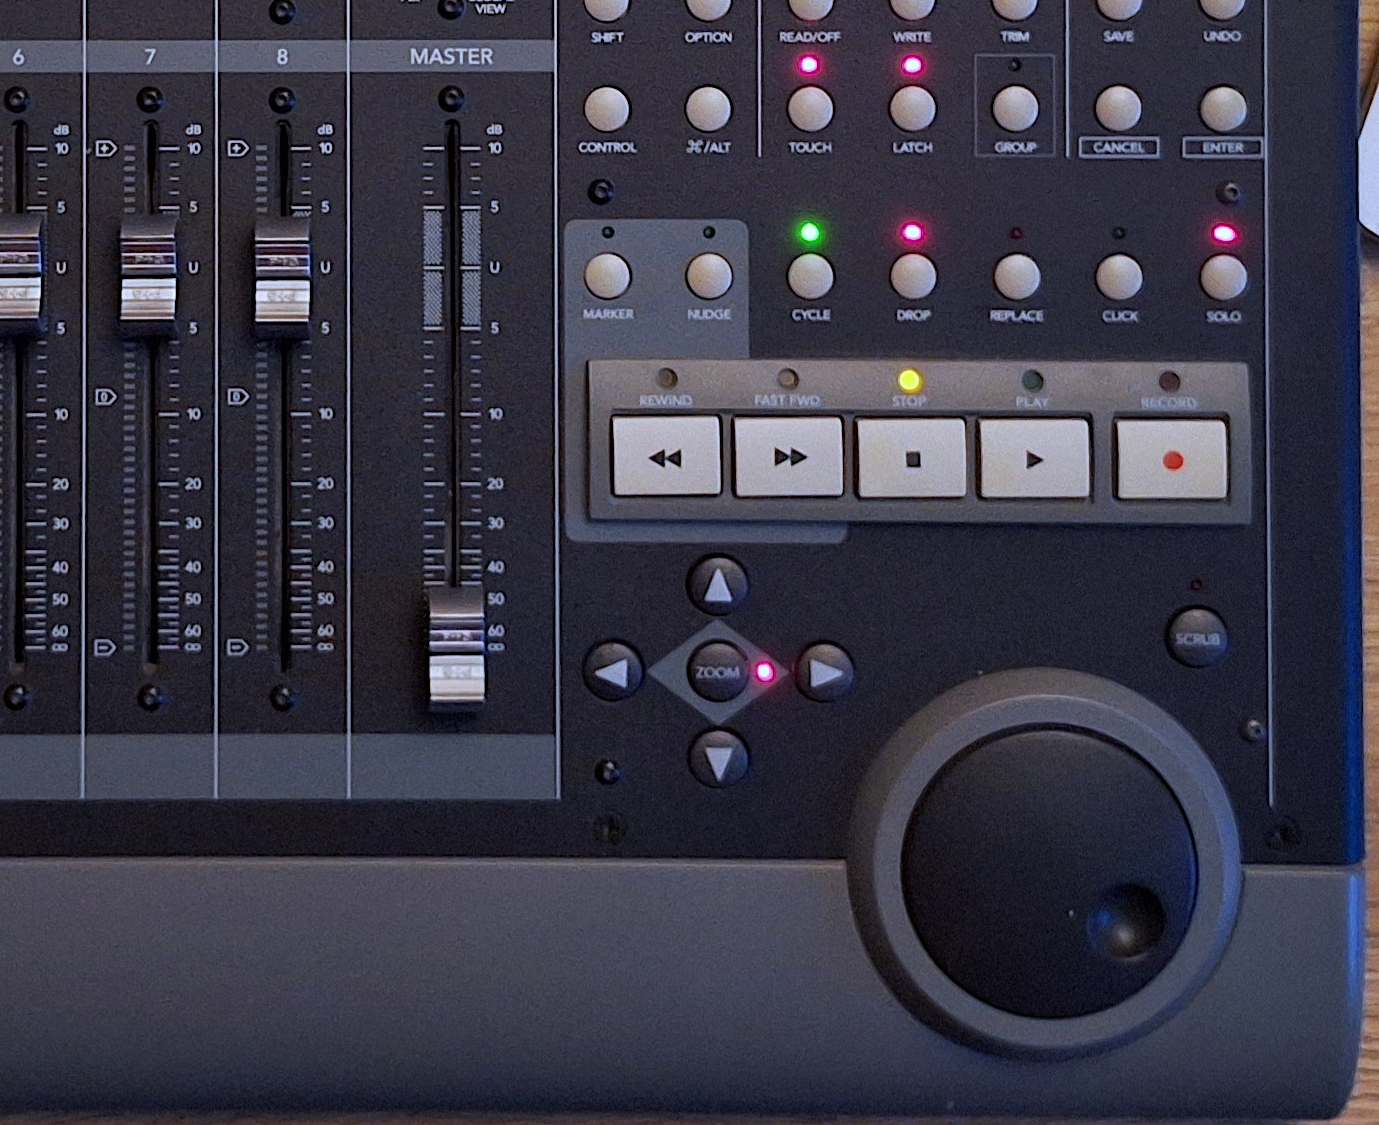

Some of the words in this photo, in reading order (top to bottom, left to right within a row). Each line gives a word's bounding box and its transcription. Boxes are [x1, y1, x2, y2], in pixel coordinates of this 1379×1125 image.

[475, 4, 507, 15] VIEW
[590, 32, 624, 43] SHIFT
[685, 32, 733, 43] OPTION
[779, 32, 842, 43] READ/OFF
[893, 32, 932, 43] WRITE
[999, 31, 1030, 42] TRIM
[1103, 31, 1134, 43] SAVE
[1203, 31, 1241, 42] UNDO
[13, 49, 25, 65] 6
[145, 49, 156, 65] 7
[277, 49, 288, 65] 8
[410, 49, 493, 65] MASTER
[486, 124, 502, 136] dB
[488, 142, 503, 154] 10
[578, 142, 638, 154] CONTROL
[789, 142, 832, 153] TOUCH
[892, 142, 933, 153] LATCH
[995, 142, 1038, 154] GROUP
[1093, 141, 1145, 154] CANCEL
[1202, 142, 1244, 153] ENTER
[583, 308, 634, 320] MARKER
[688, 309, 731, 320] NUDGE
[792, 309, 831, 321] CYCLE
[896, 309, 931, 321] DROP
[990, 310, 1044, 322] REPLACE
[1102, 310, 1139, 322] CLICK
[1206, 311, 1241, 322] SOLO
[639, 395, 693, 407] REWIND
[754, 395, 786, 406] FAST
[789, 395, 820, 406] FWD
[892, 395, 926, 407] STOP
[1016, 396, 1049, 408] PLAY
[1141, 397, 1198, 409] RECORD
[487, 477, 504, 490] 20
[487, 560, 504, 573] 40
[696, 667, 740, 679] ZOOM
